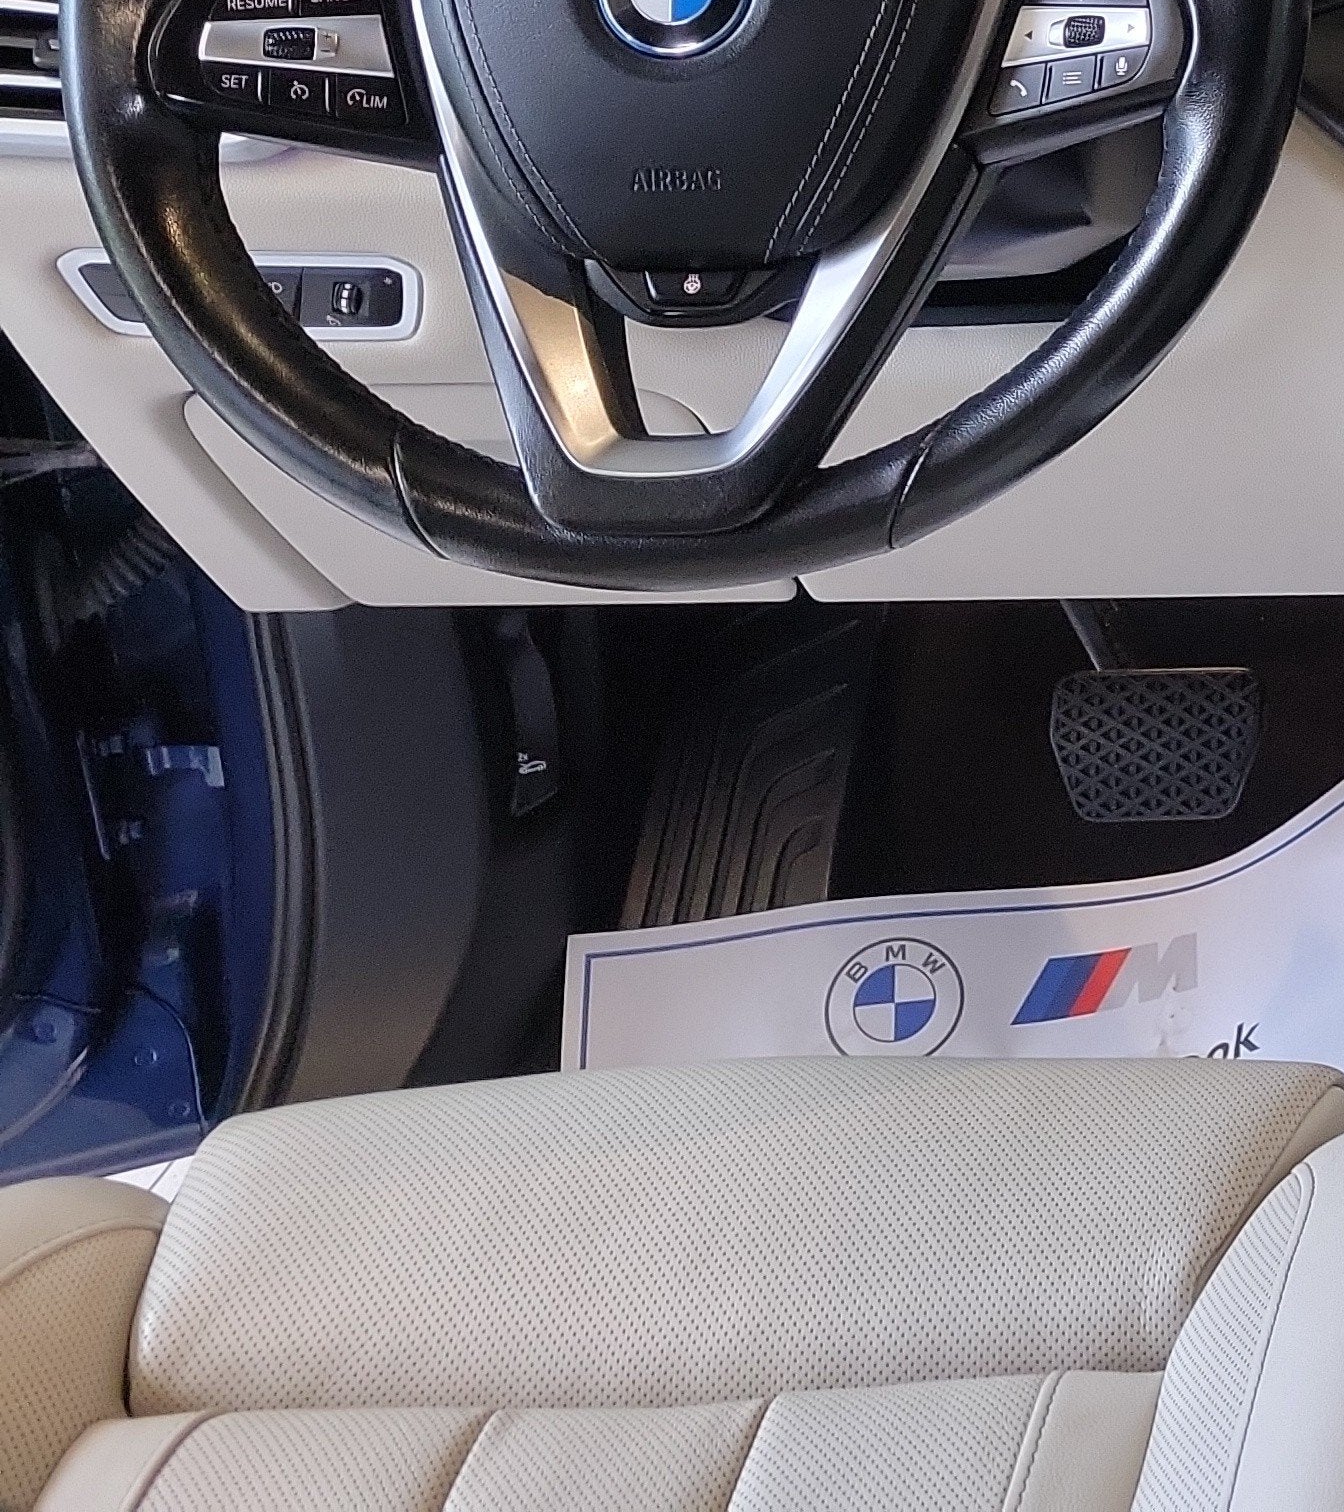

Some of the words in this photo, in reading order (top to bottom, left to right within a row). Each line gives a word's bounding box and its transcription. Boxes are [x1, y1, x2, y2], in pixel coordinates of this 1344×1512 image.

[220, 73, 249, 89] SET
[361, 94, 389, 110] LIM
[633, 167, 722, 192] AIRBAG
[845, 944, 945, 984] BMW
